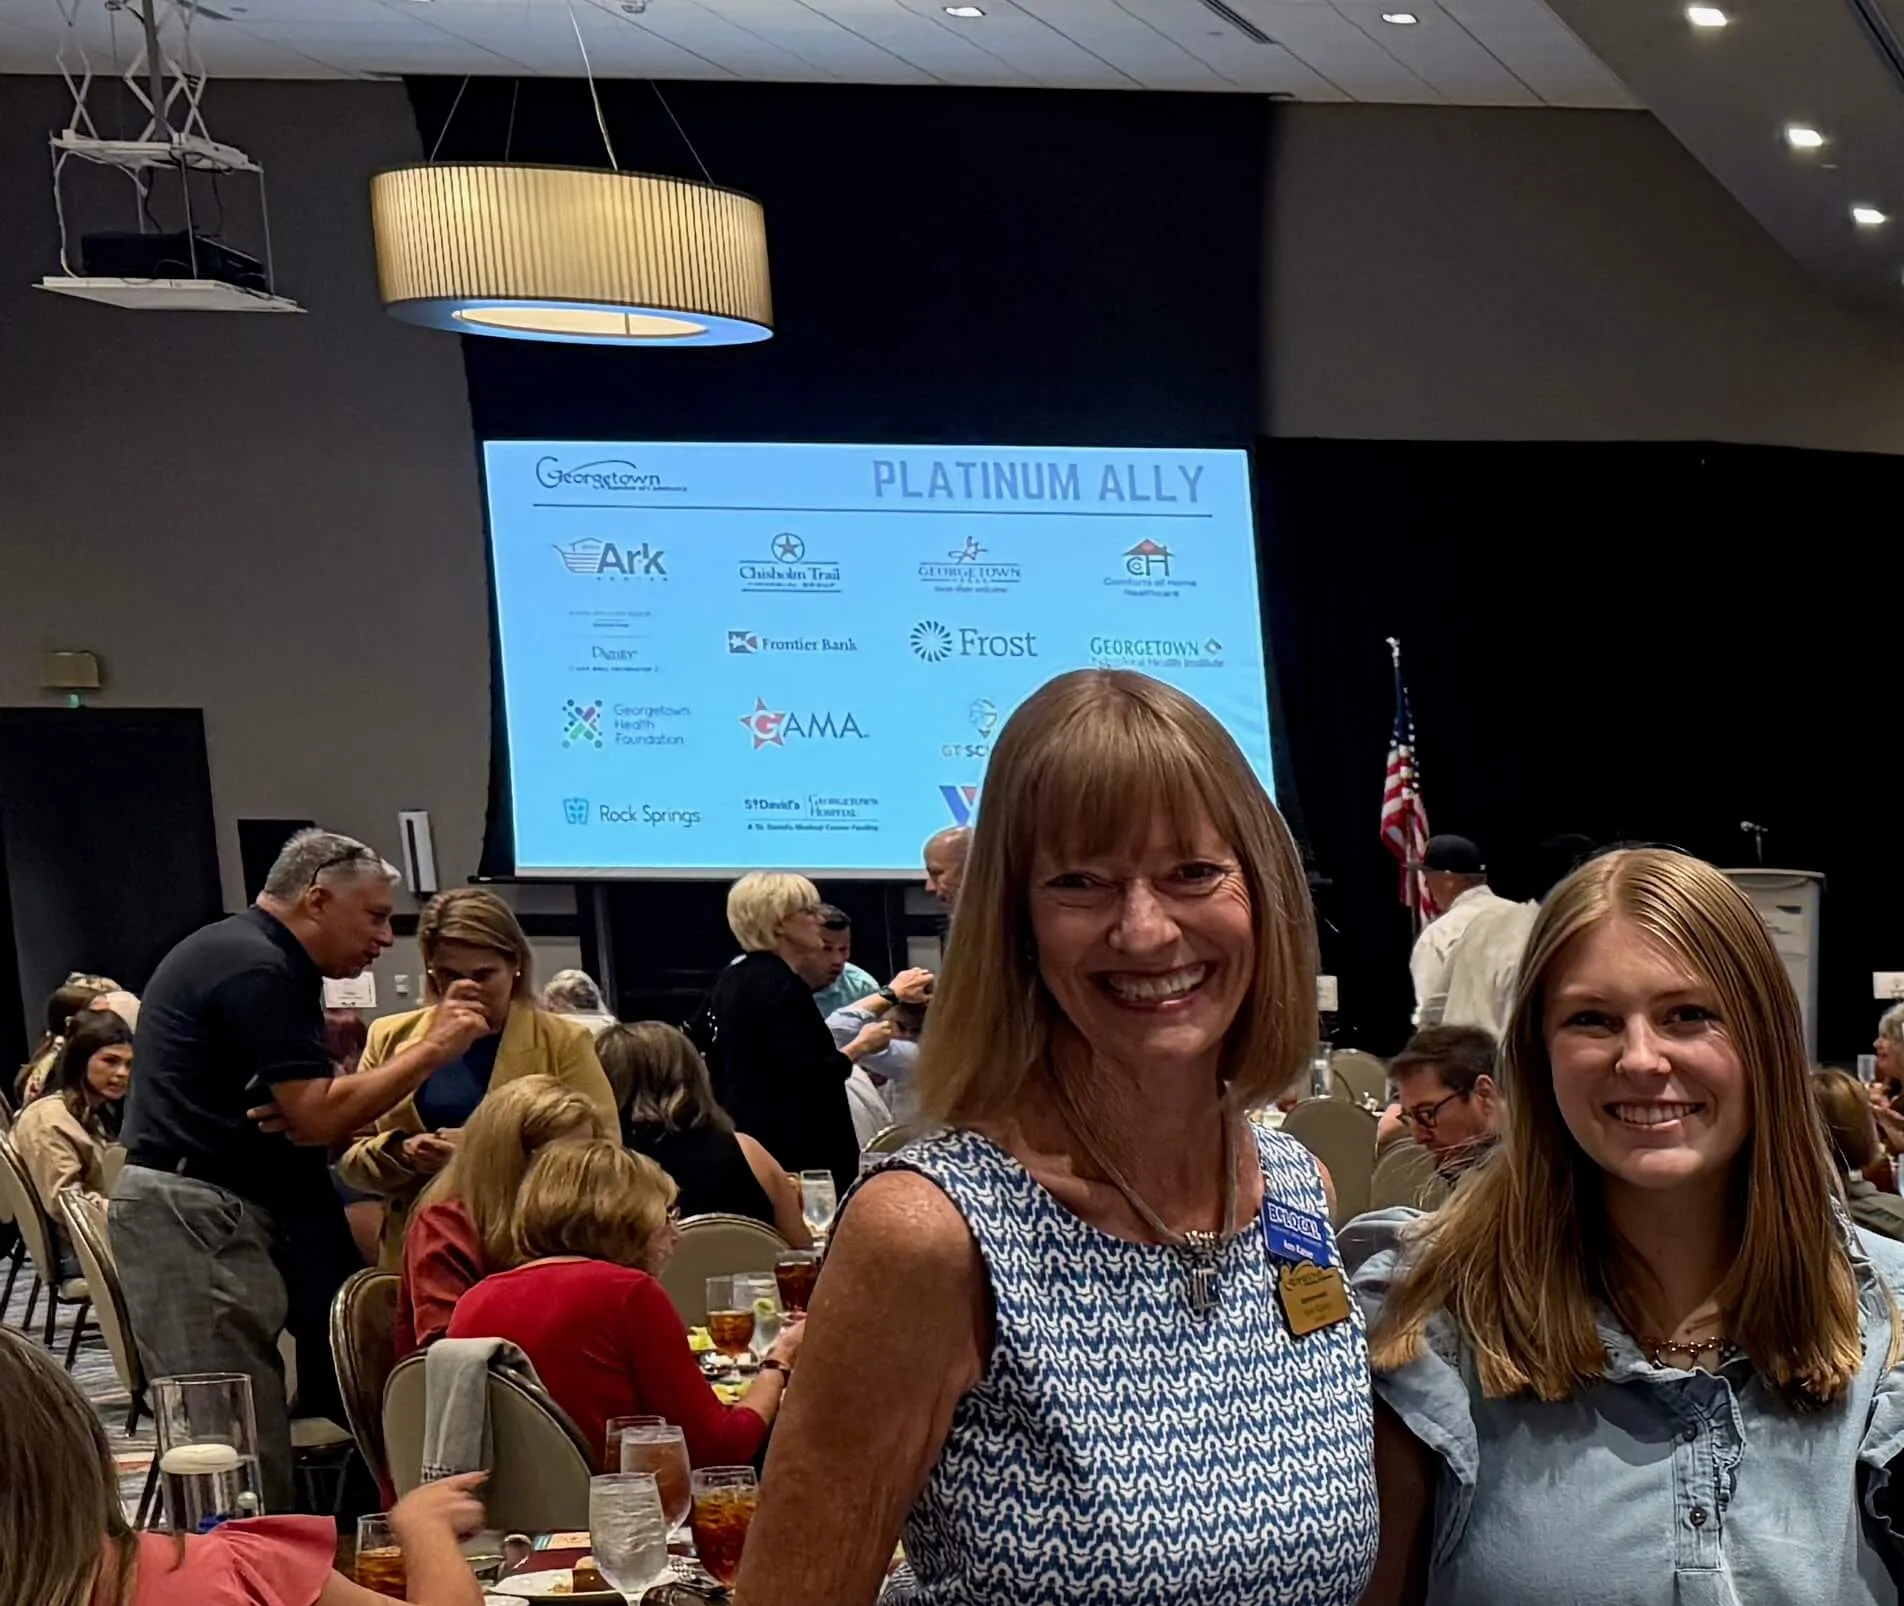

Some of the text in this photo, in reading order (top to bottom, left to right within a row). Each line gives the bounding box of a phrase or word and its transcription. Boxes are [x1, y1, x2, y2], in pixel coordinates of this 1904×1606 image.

[536, 456, 660, 489] Georgetown
[873, 460, 1204, 502] PLATINUM ALLY
[597, 542, 667, 575] Ark
[740, 567, 840, 581] Chisholm Trail
[919, 566, 1020, 578] GEORGETOWN
[762, 638, 858, 651] Frontier Bank
[959, 628, 1038, 657] Frost
[1090, 637, 1198, 656] GEORGETOWN
[614, 703, 690, 719] Georgetown
[615, 719, 654, 731] Health
[751, 710, 865, 739] GAMA
[616, 733, 684, 746] Foundation
[600, 805, 700, 827] Rock Springs
